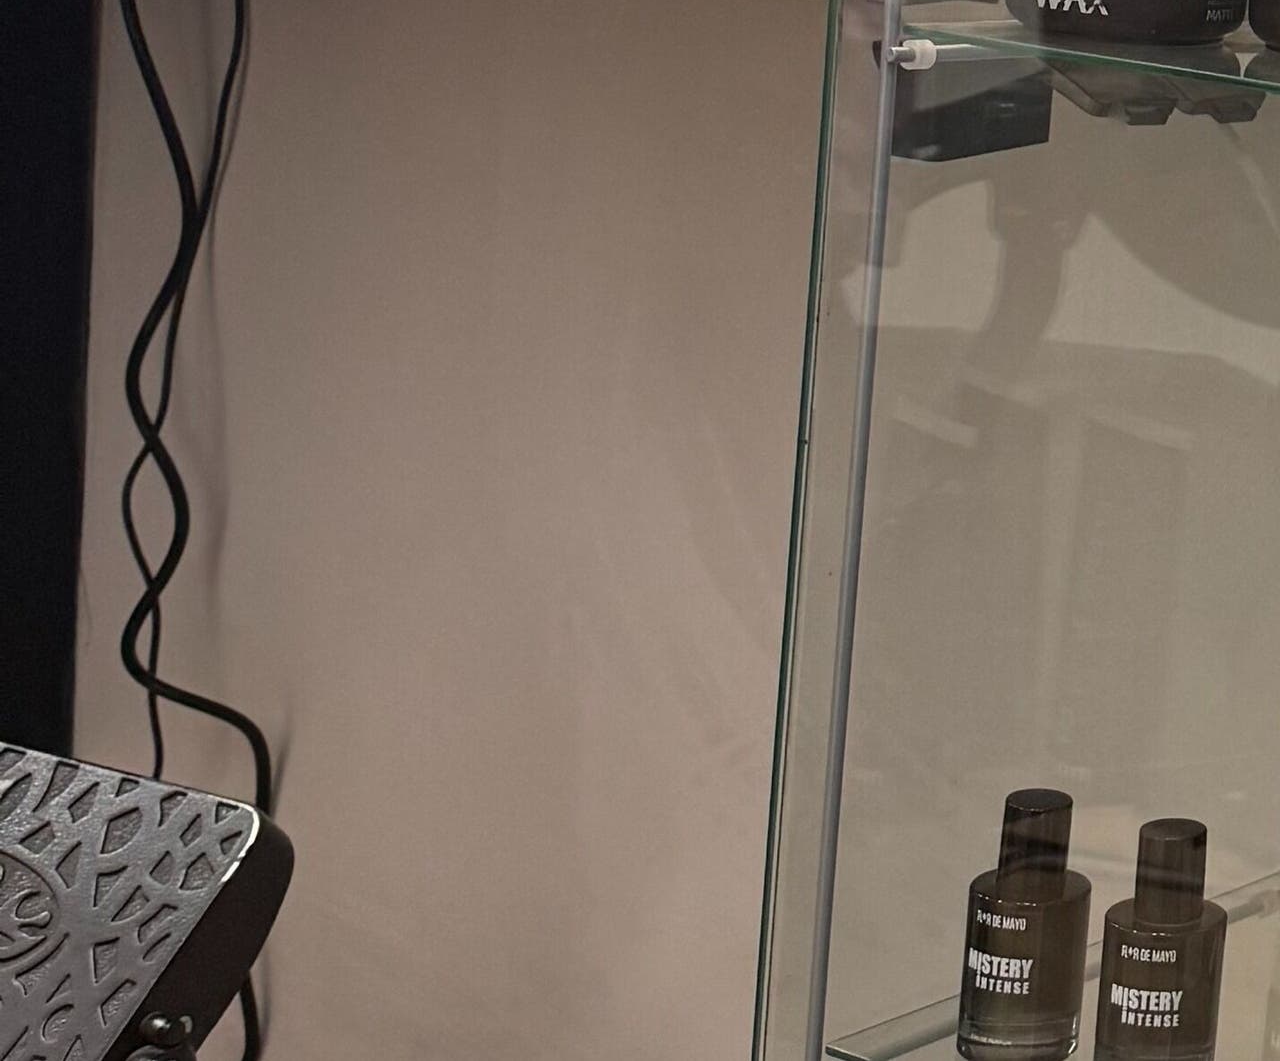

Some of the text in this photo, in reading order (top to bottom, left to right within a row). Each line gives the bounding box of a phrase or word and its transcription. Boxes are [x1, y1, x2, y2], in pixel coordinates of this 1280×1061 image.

[1206, 9, 1233, 22] MATT
[968, 947, 1033, 979] MISTERY
[975, 972, 1030, 995] INTENSE
[1111, 983, 1183, 1012] MISTERY
[1121, 1006, 1179, 1028] INTENSE
